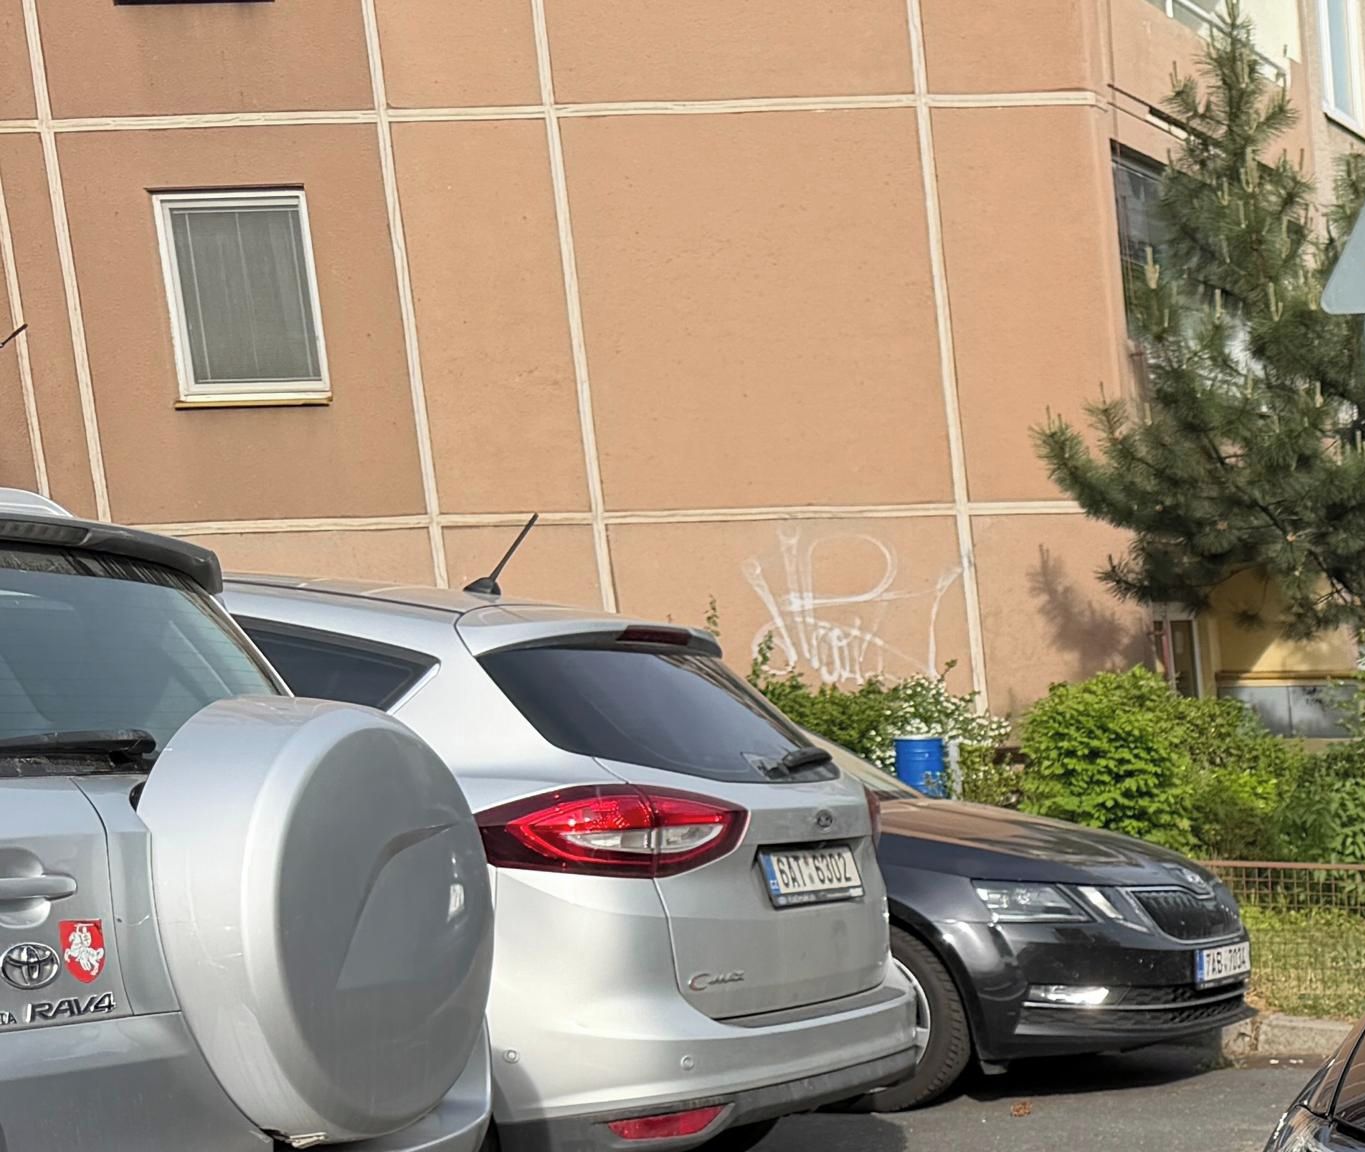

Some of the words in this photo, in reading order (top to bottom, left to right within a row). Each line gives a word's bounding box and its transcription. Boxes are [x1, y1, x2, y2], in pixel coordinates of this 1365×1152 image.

[776, 855, 807, 888] 6AT
[813, 852, 852, 884] 6302
[25, 991, 117, 1023] RAV4
